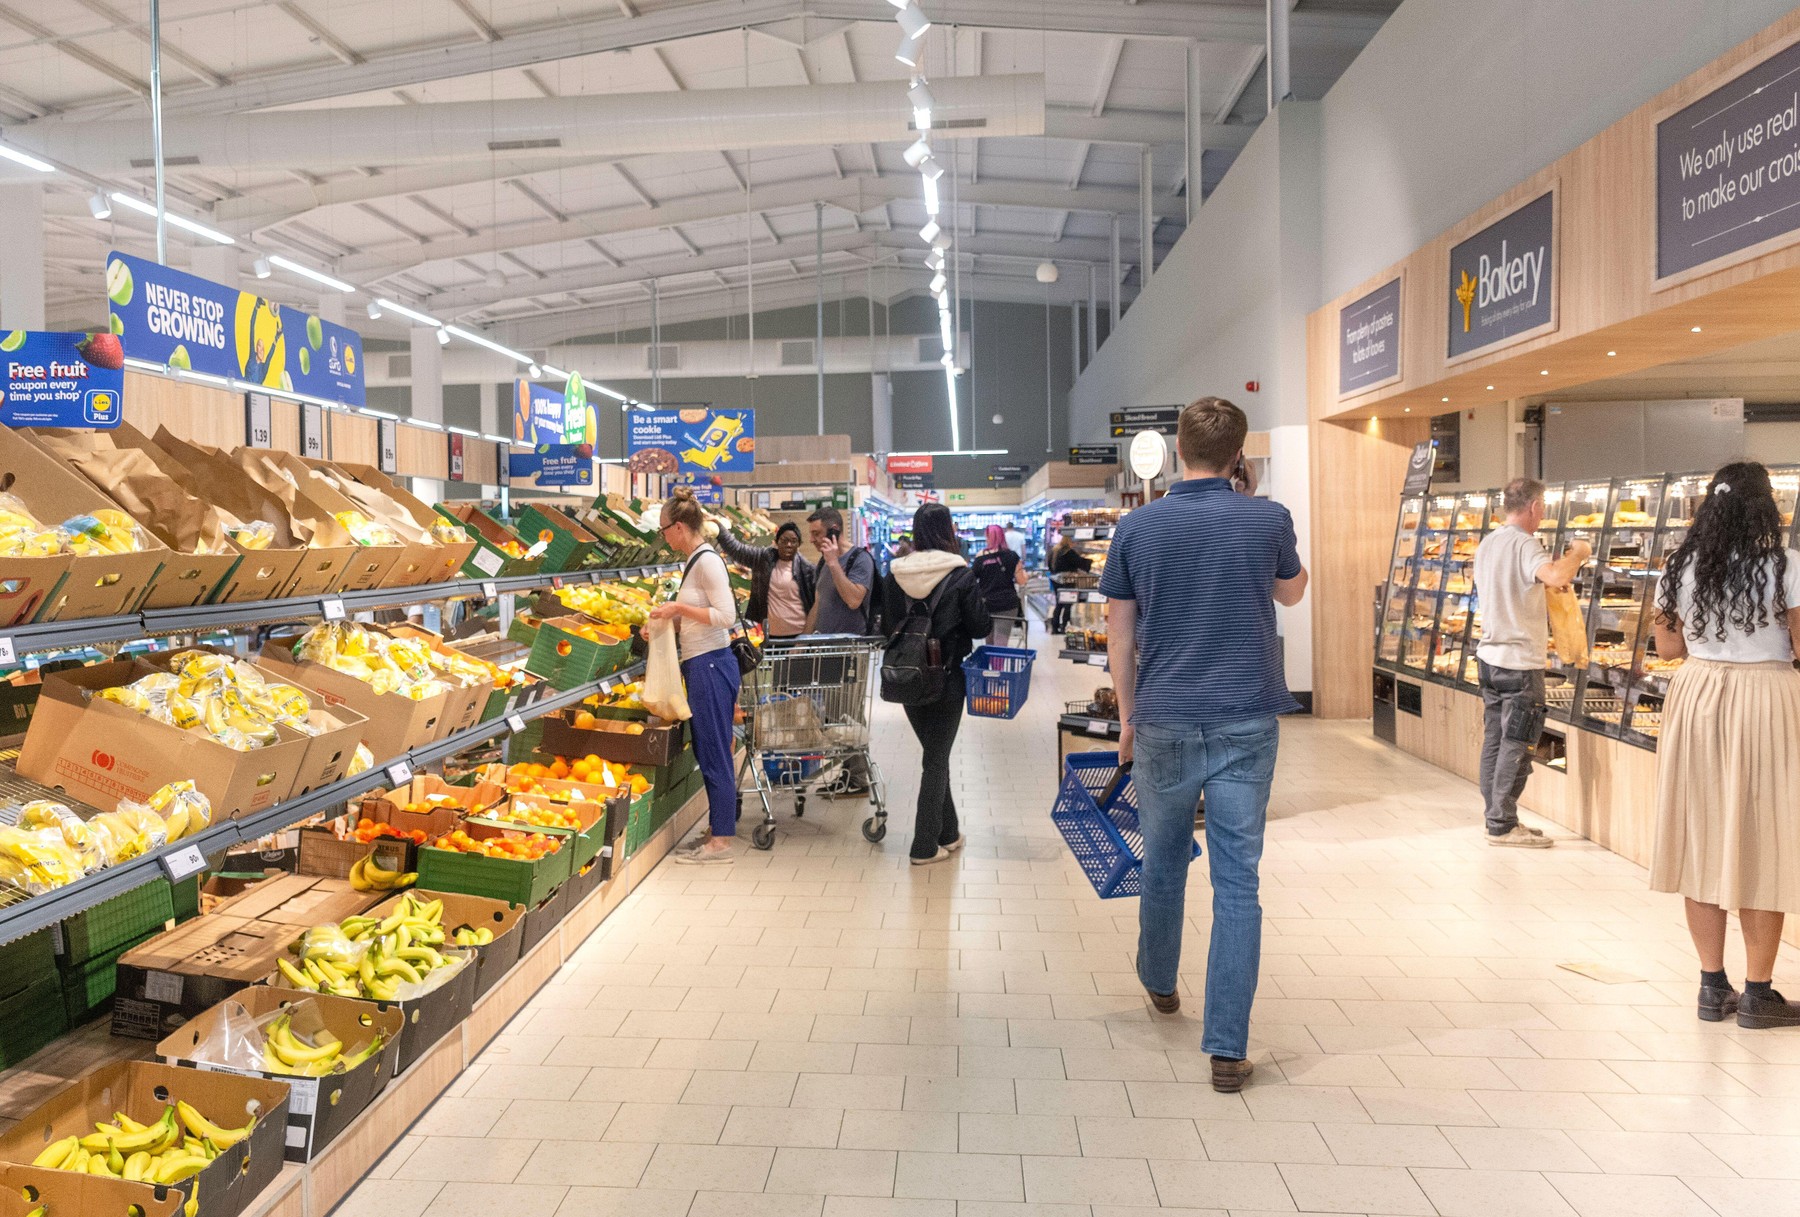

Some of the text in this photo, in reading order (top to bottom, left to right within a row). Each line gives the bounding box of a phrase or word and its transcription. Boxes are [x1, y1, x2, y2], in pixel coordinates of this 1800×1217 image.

[1680, 92, 1797, 181] We only use real
[1682, 197, 1695, 221] to
[1698, 173, 1736, 214] make
[1739, 166, 1765, 195] our
[1479, 239, 1545, 308] Bakery
[145, 281, 224, 323] NEVER STOP
[147, 305, 225, 350] GROWING
[8, 360, 88, 379] Free fruit
[9, 381, 77, 391] coupon every
[9, 391, 32, 401] time
[33, 393, 53, 402] you
[94, 412, 109, 420] Plus
[633, 415, 678, 424] Be a smart
[254, 428, 268, 443] 1.39
[633, 425, 662, 434] cookie
[308, 437, 319, 450] 99p
[542, 456, 577, 466] Free fruit
